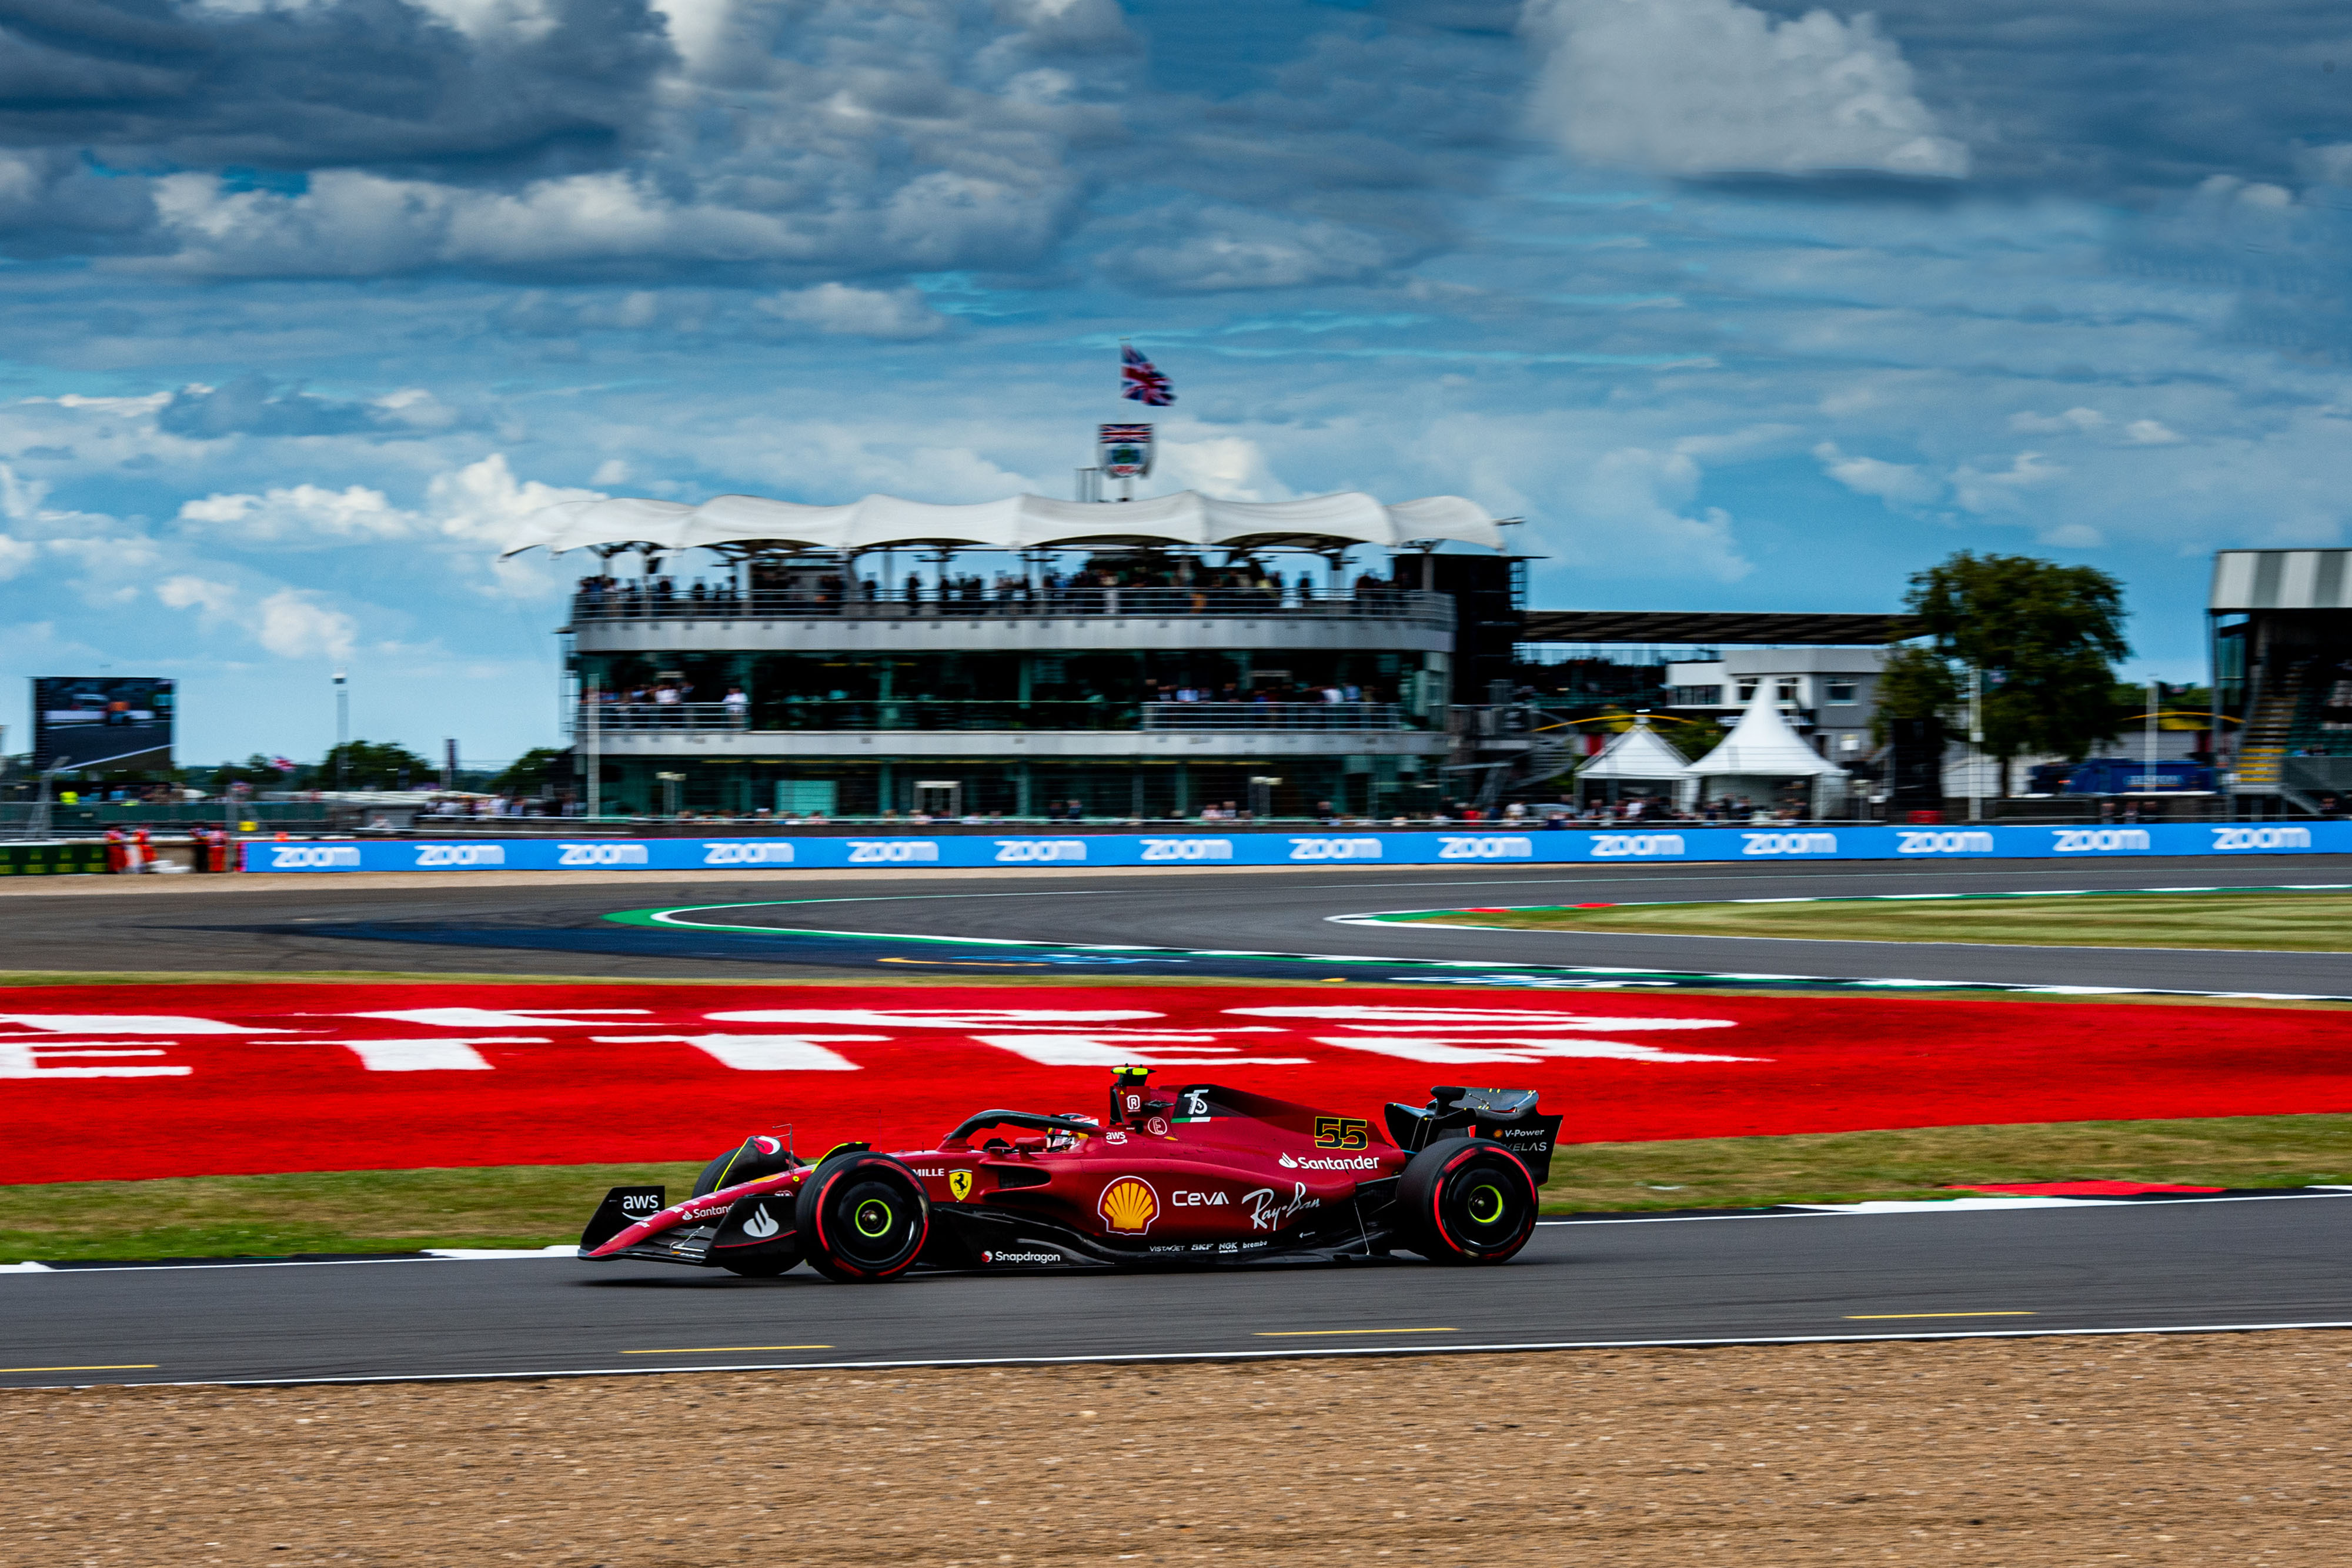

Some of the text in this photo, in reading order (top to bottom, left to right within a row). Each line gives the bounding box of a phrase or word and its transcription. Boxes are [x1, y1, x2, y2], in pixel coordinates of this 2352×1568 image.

[1289, 838, 1382, 859] zoom
[1437, 837, 1532, 858] zoom
[1590, 835, 1684, 856] zoom
[1740, 833, 1836, 854] zoom
[1896, 831, 1993, 853] zoom
[2052, 829, 2150, 852] zoom
[2211, 827, 2311, 850] zoom
[270, 846, 360, 868] zoom
[415, 845, 505, 866] zoom
[557, 844, 647, 865] zoom
[703, 843, 794, 863] zoom
[847, 841, 938, 862] zoom
[994, 841, 1086, 861] zoom
[1140, 839, 1232, 860] zoom
[1106, 1131, 1127, 1140] aws
[1314, 1116, 1368, 1151] 55
[1505, 1129, 1545, 1138] V-Power
[1298, 1155, 1379, 1170] Santander
[623, 1195, 659, 1209] aws
[1218, 1242, 1238, 1250] NGK
[1242, 1241, 1268, 1249] brembo
[995, 1251, 1061, 1263] Snapdragon
